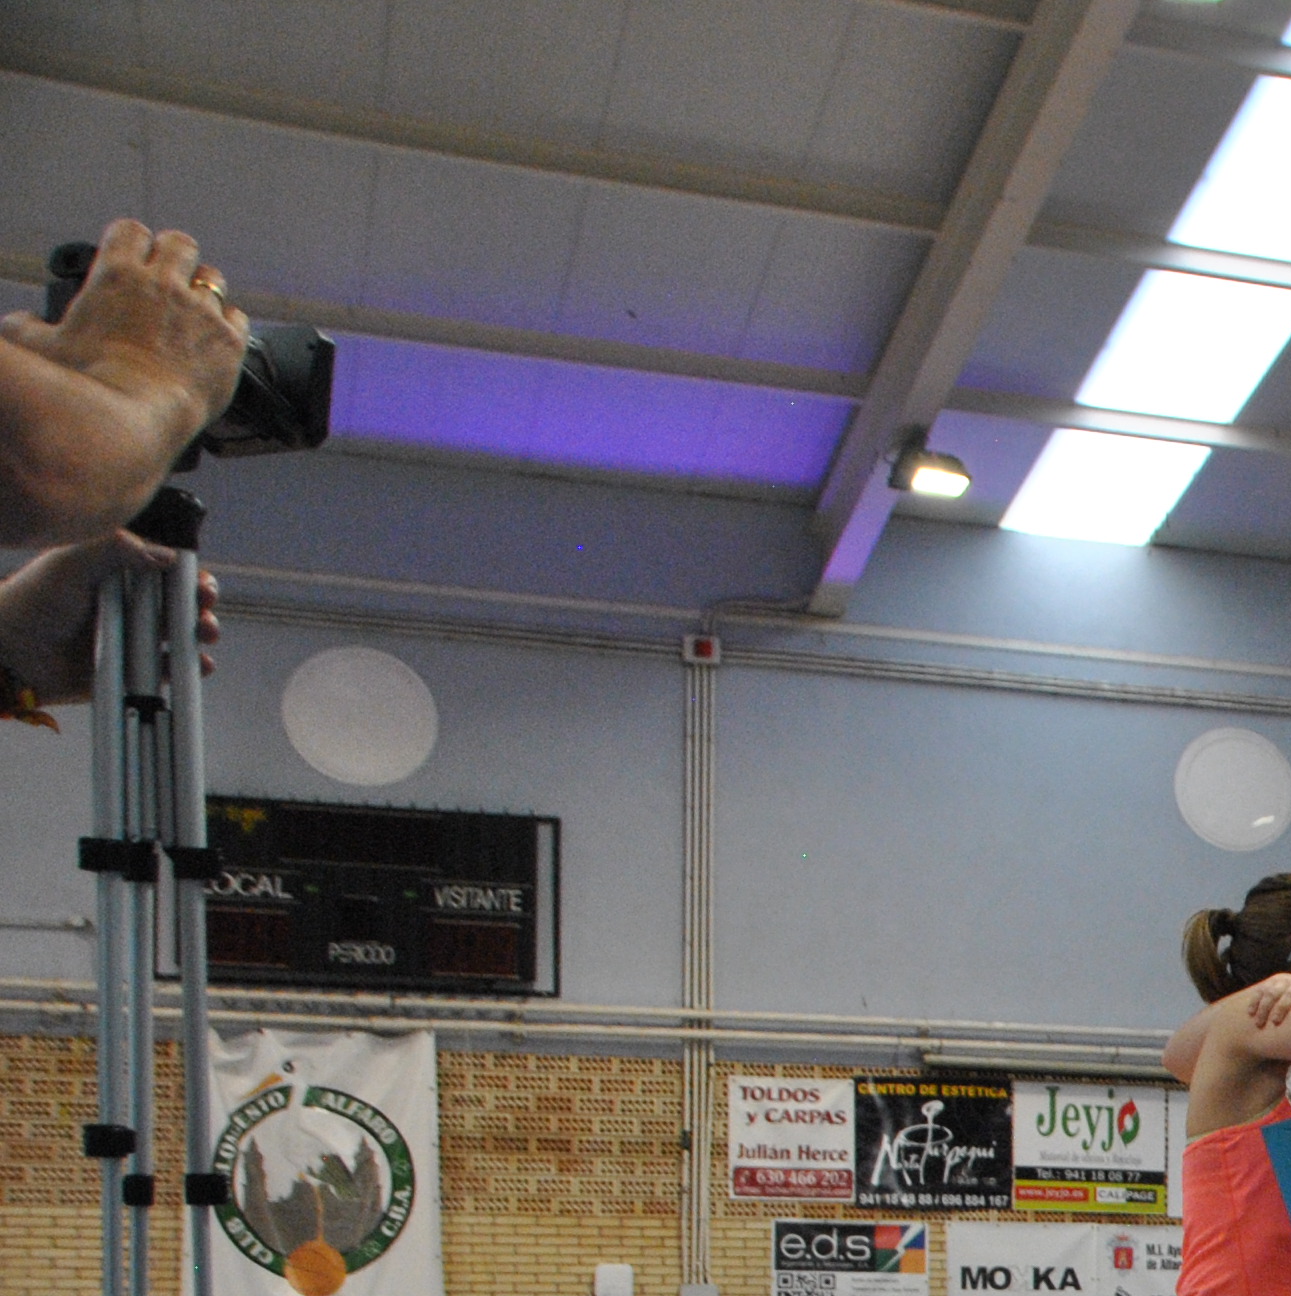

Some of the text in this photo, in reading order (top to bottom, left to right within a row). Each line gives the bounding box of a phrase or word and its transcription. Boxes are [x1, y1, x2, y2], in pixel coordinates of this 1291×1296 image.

[739, 1085, 820, 1103] TOLDOS
[857, 1082, 916, 1095] CENTRO
[919, 1083, 938, 1096] DE
[320, 1090, 398, 1145] ALFARO
[746, 1107, 847, 1126] y CARPAS
[1036, 1086, 1140, 1151] Jeyjo
[798, 1145, 849, 1162] Herce
[780, 1227, 872, 1261] e.d.s
